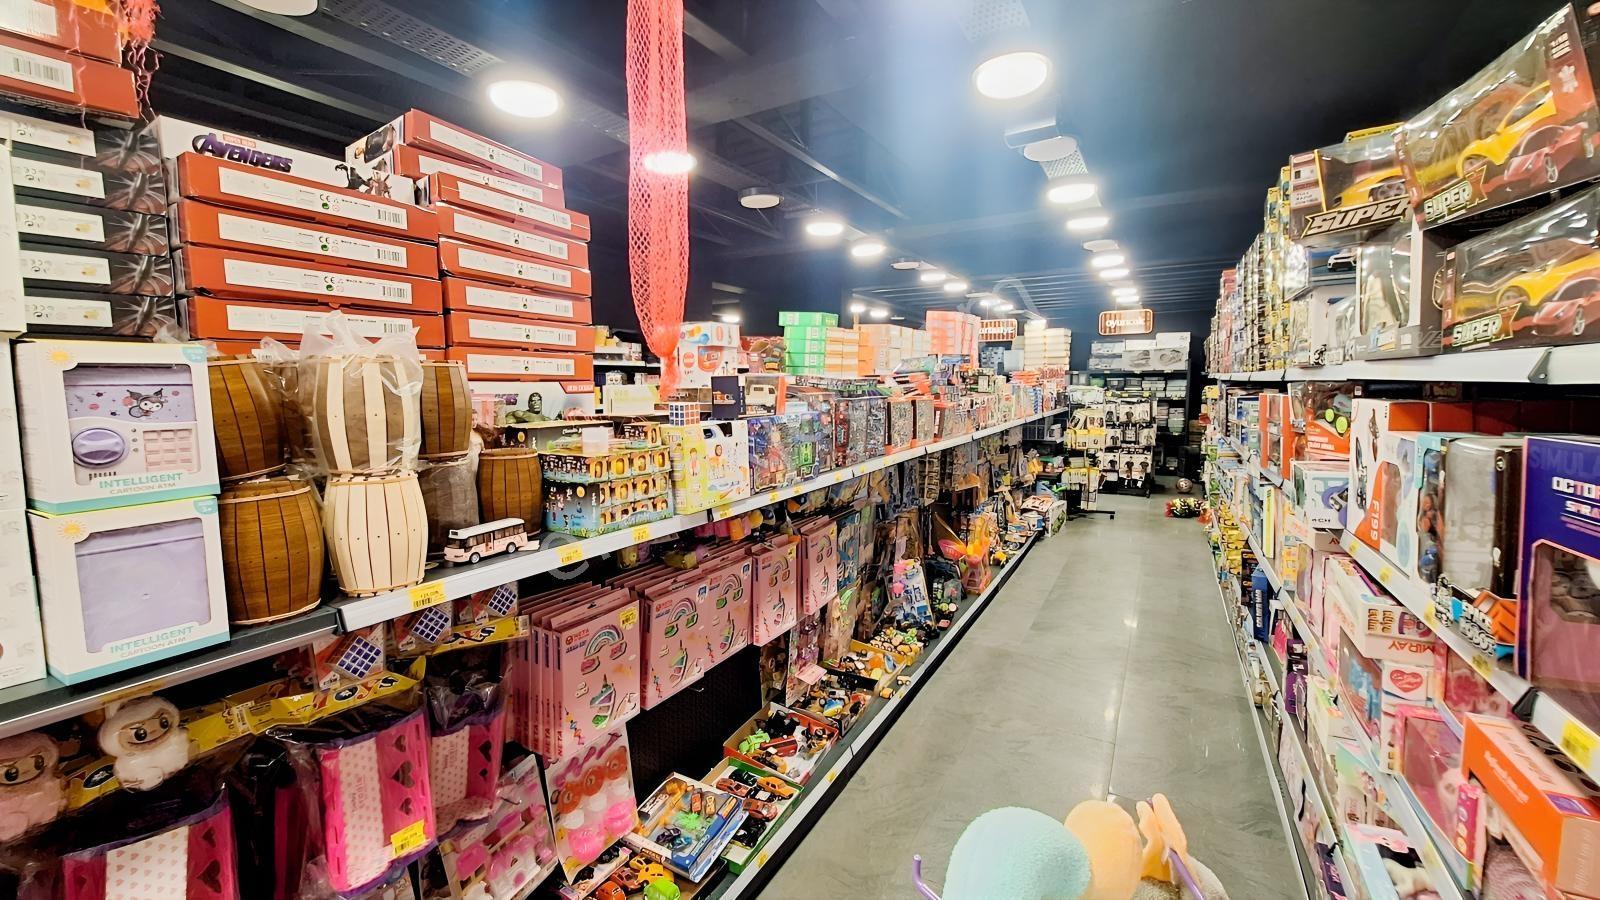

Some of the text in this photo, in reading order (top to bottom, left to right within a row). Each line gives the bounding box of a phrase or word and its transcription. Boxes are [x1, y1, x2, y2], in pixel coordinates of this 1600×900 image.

[1424, 180, 1472, 222] SUPER
[1452, 313, 1502, 346] SUPER
[99, 472, 183, 489] INTELLIGENT
[111, 482, 176, 495] CARTOON ATM
[1369, 500, 1380, 541] F199
[110, 625, 194, 653] INTELLIGENT
[120, 643, 165, 657] CARTOON
